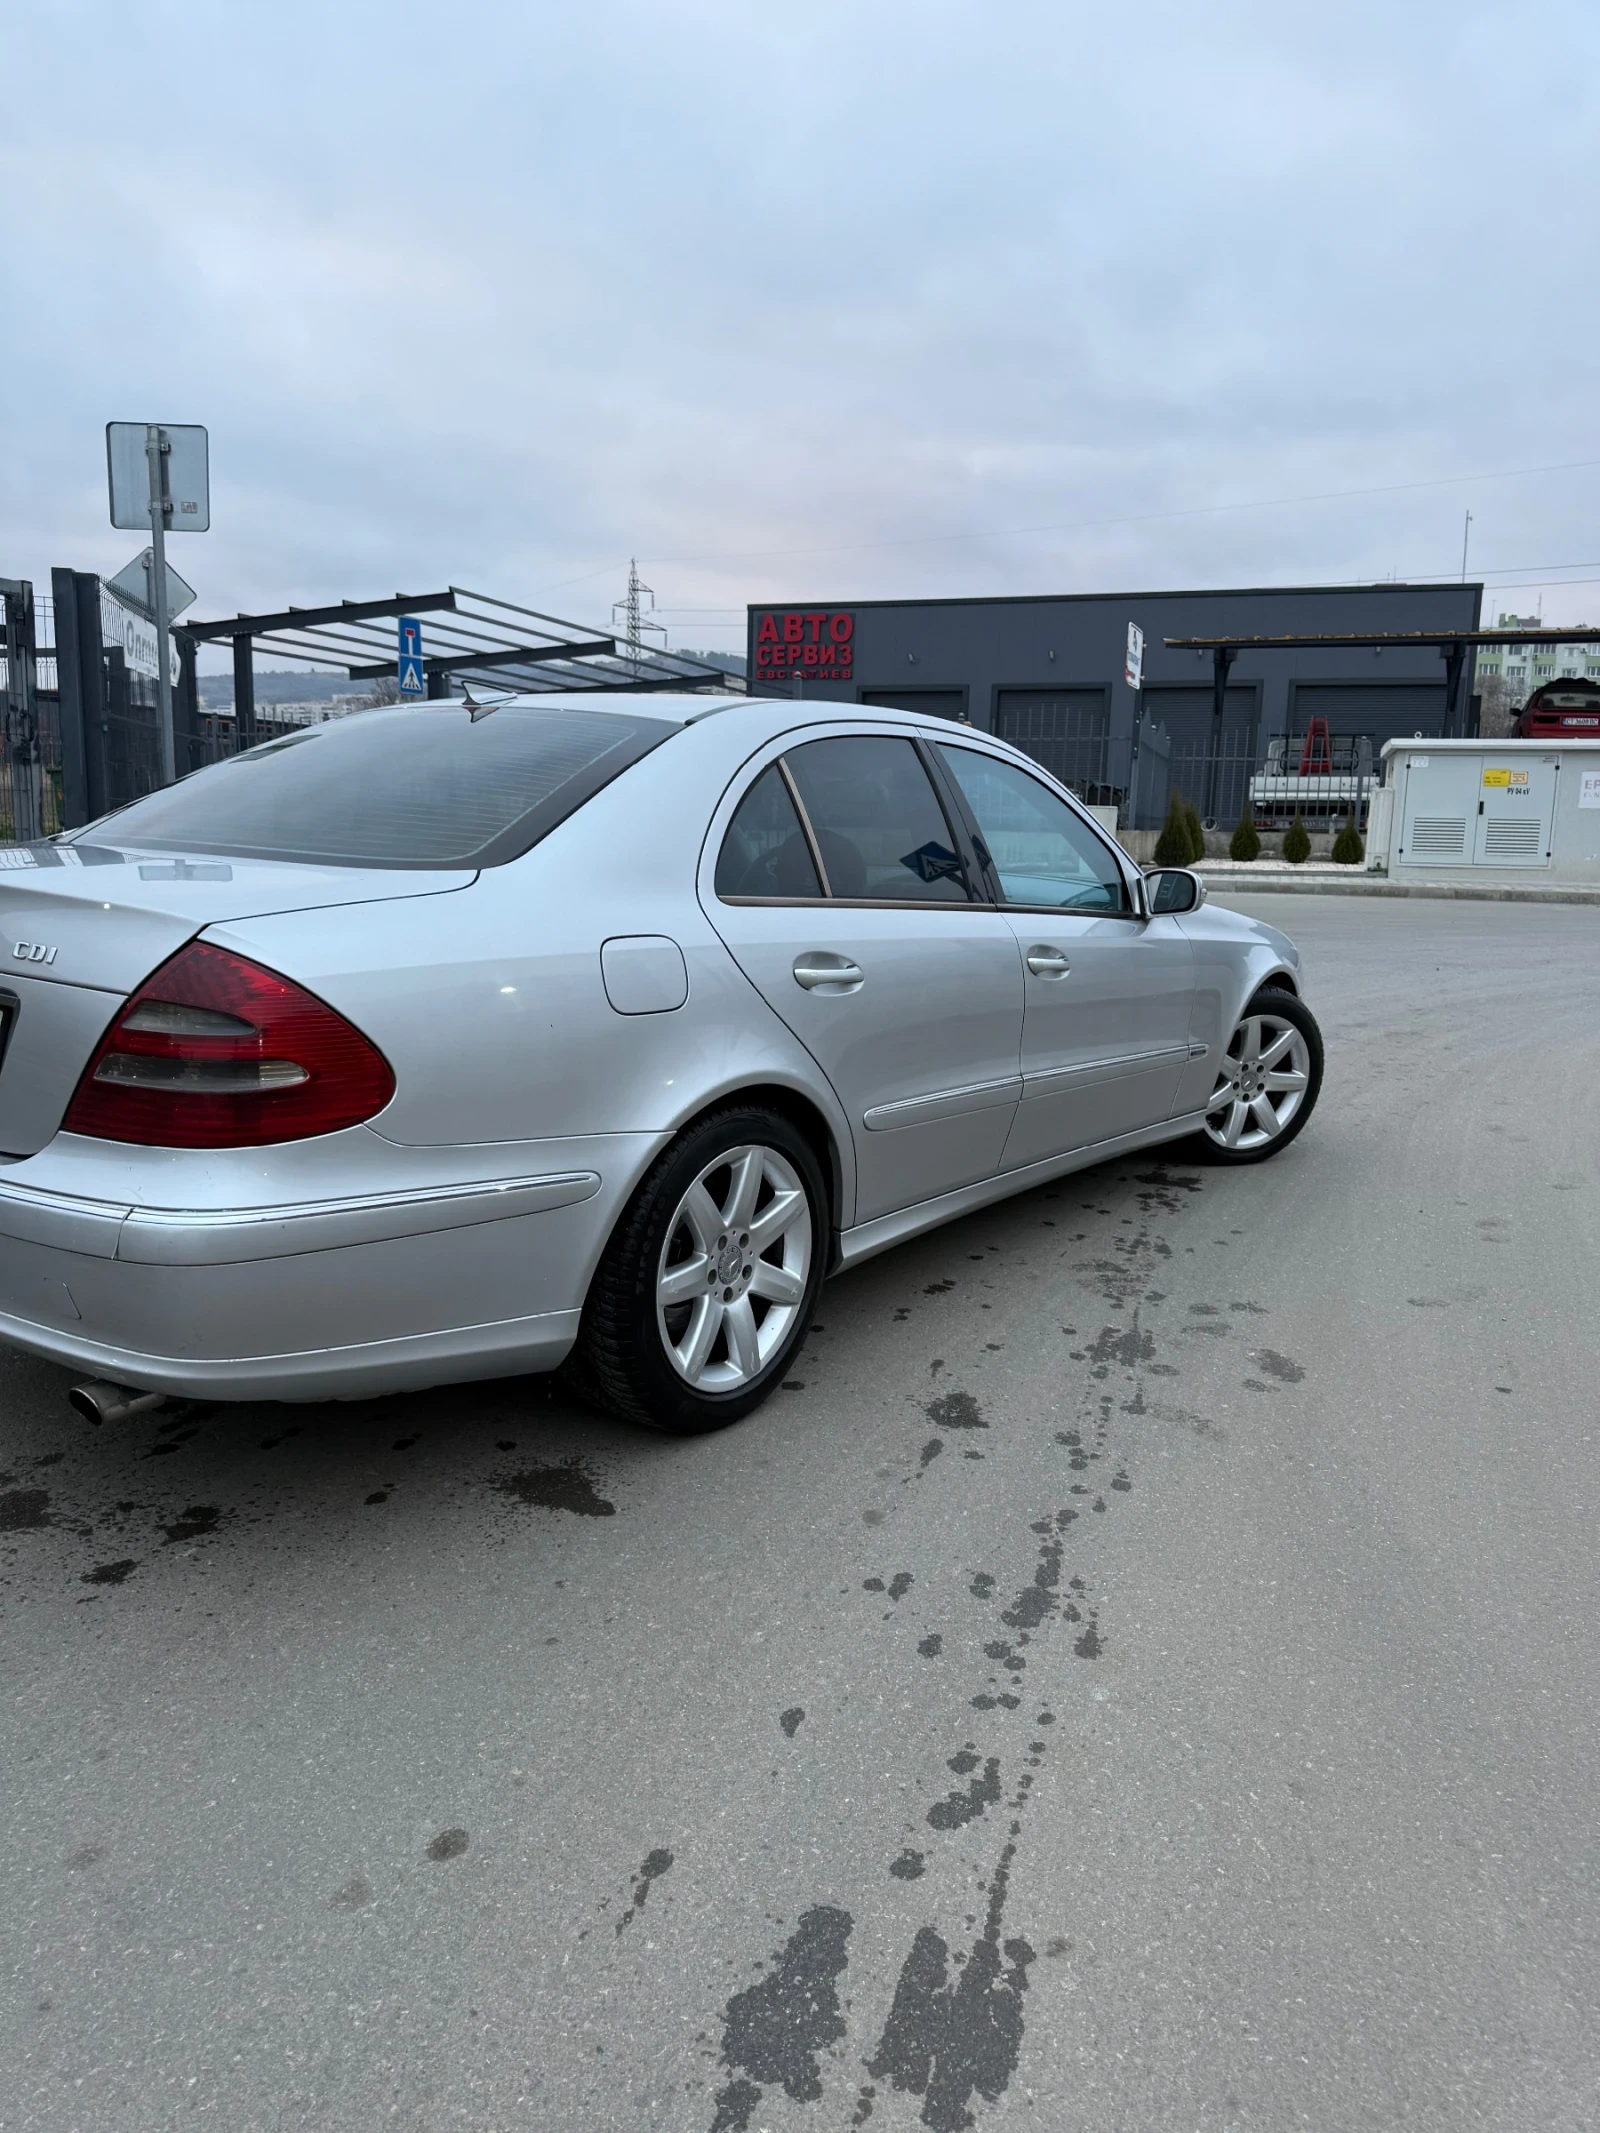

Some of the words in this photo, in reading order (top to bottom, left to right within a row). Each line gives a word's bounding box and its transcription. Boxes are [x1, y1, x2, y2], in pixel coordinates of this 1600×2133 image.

[757, 612, 853, 643] АВТО
[756, 644, 852, 666] СЕРВИЗ
[12, 941, 58, 965] CDI
